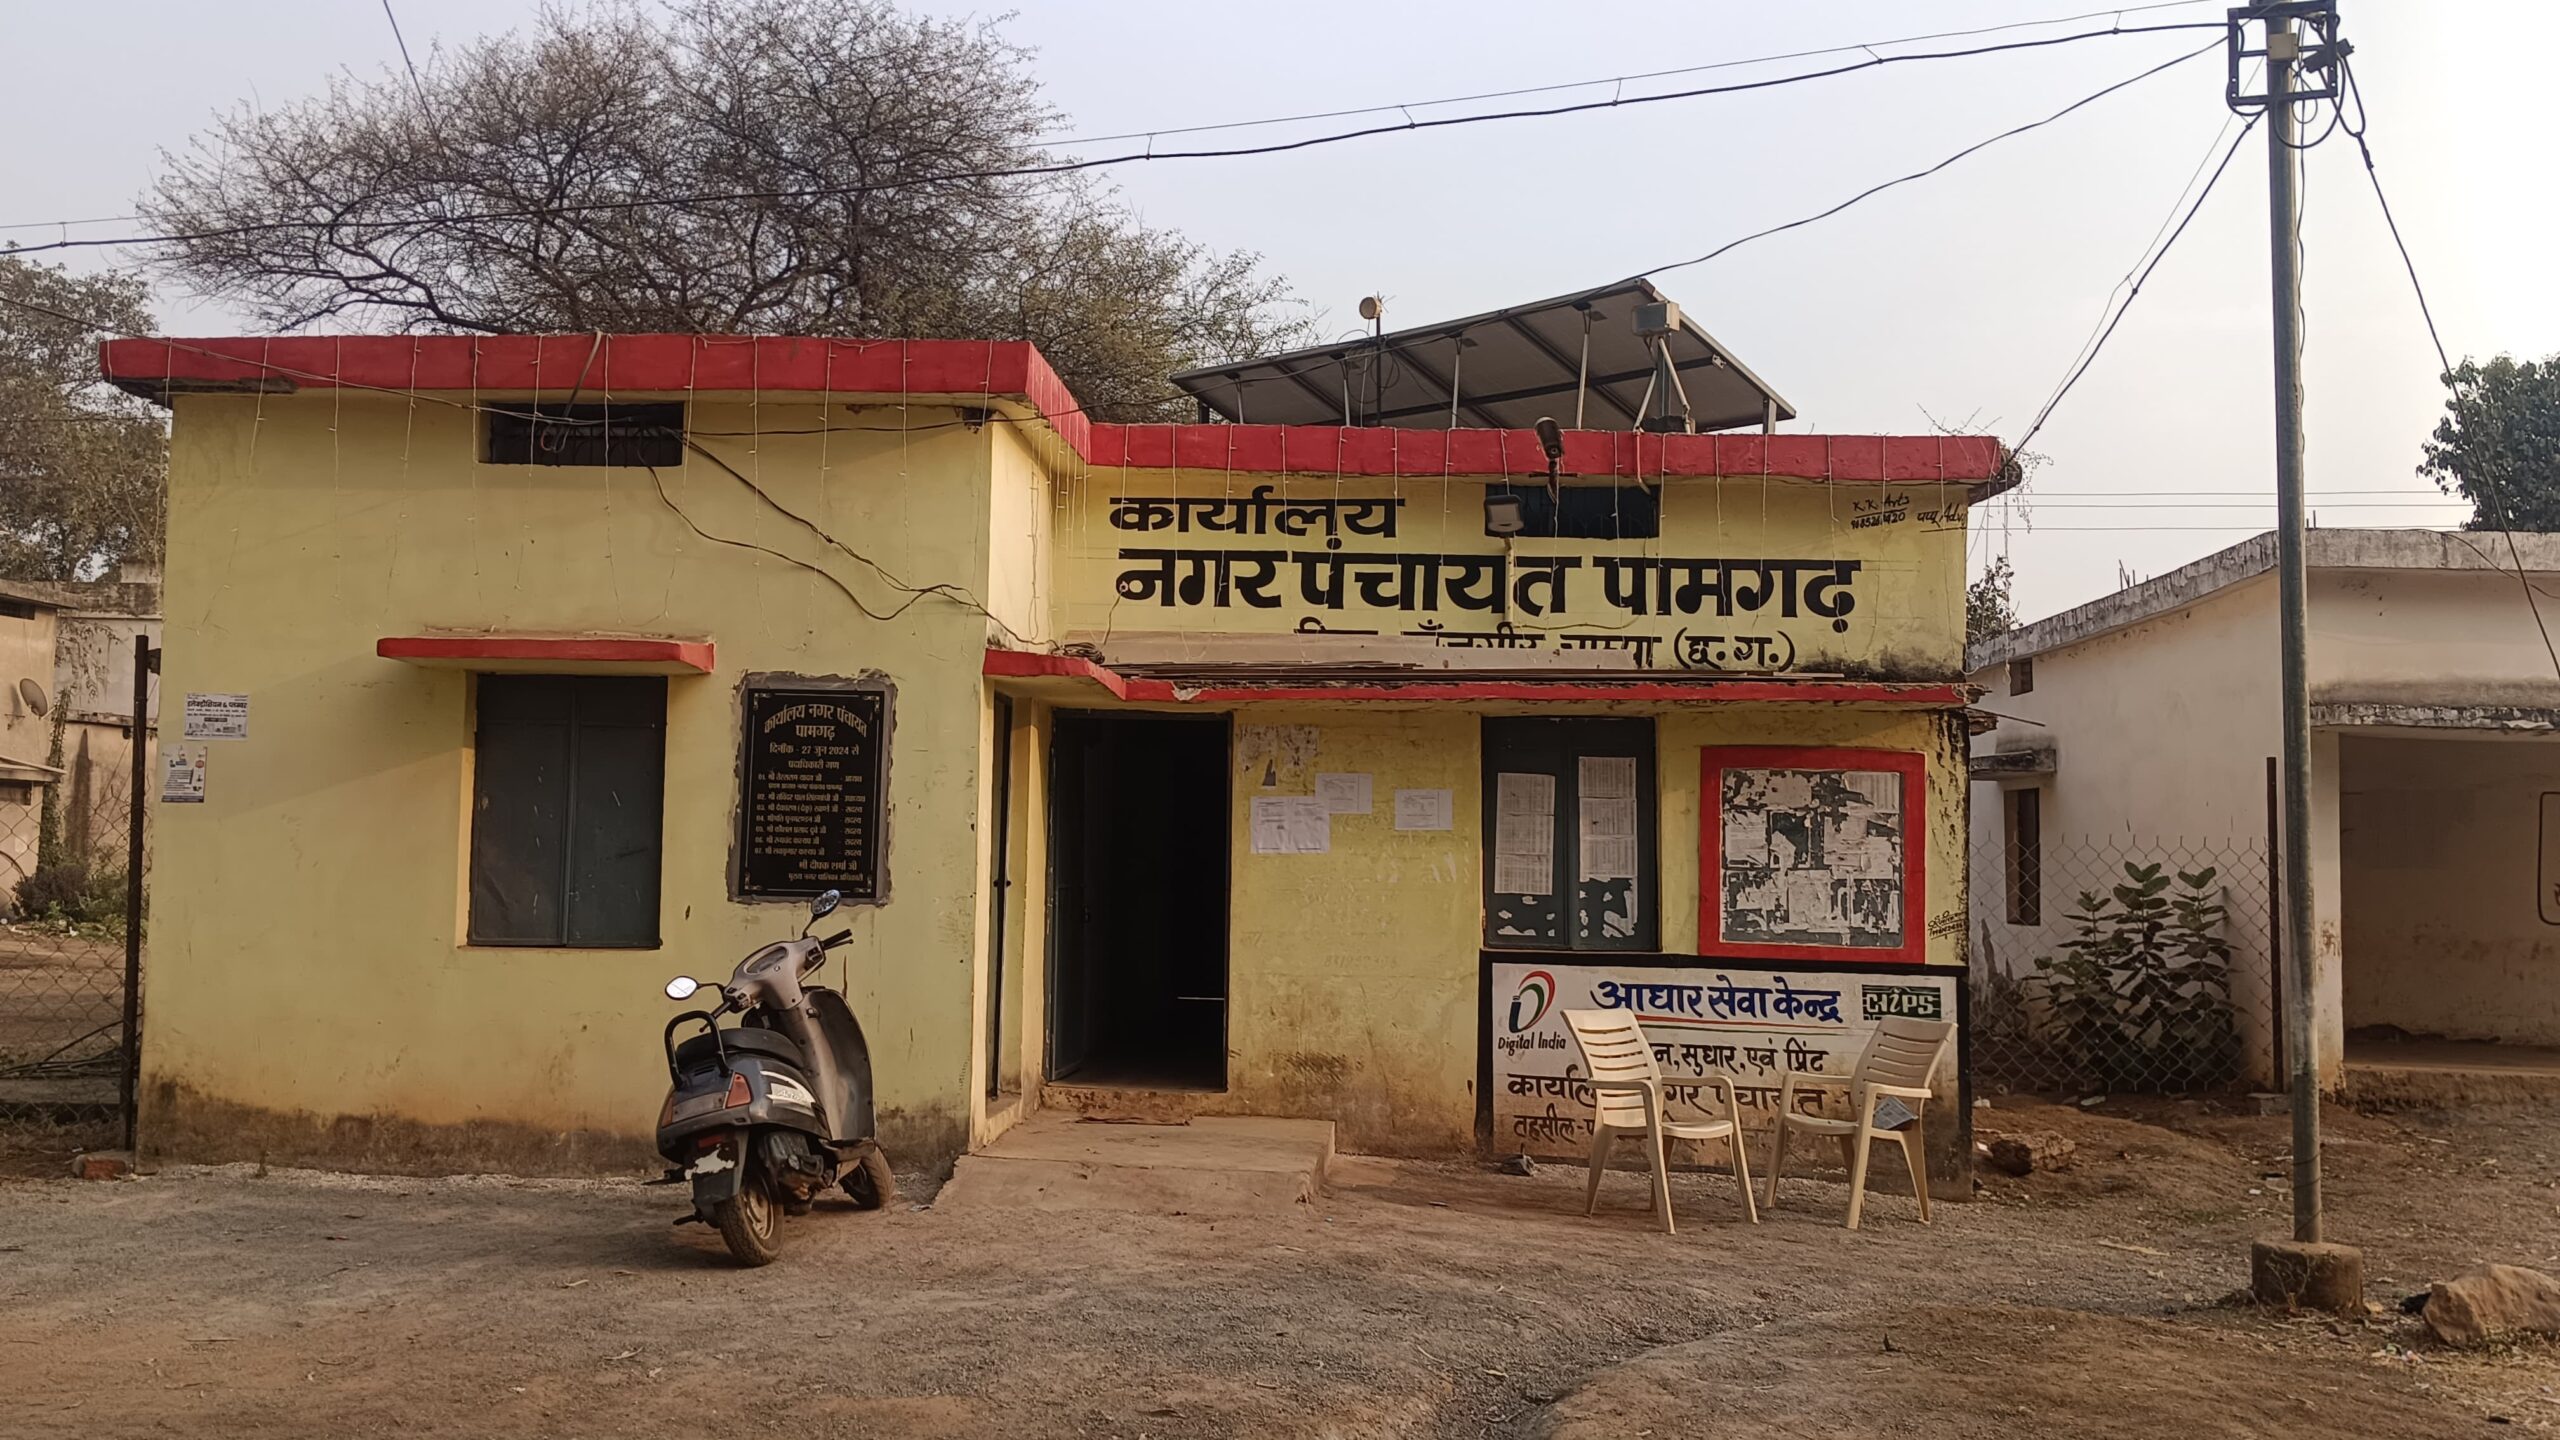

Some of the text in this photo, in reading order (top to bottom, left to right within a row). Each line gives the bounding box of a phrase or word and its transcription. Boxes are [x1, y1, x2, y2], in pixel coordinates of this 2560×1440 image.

[1109, 485, 1406, 538] कार्यालय
[1116, 537, 1862, 634] नगर पंचायत पामगढ़
[764, 703, 868, 738] कार्यालय नगर पंचायत
[795, 725, 836, 741] पामगढ़
[801, 745, 812, 755] 27
[828, 746, 849, 755] 2024
[1590, 975, 1843, 1023] आधार सेवा केन्द्र
[1498, 1031, 1567, 1057] Digital India
[1783, 1036, 1829, 1072] प्रिंट
[1507, 1064, 1597, 1108] कार्याल
[1661, 1083, 1713, 1116] गर
